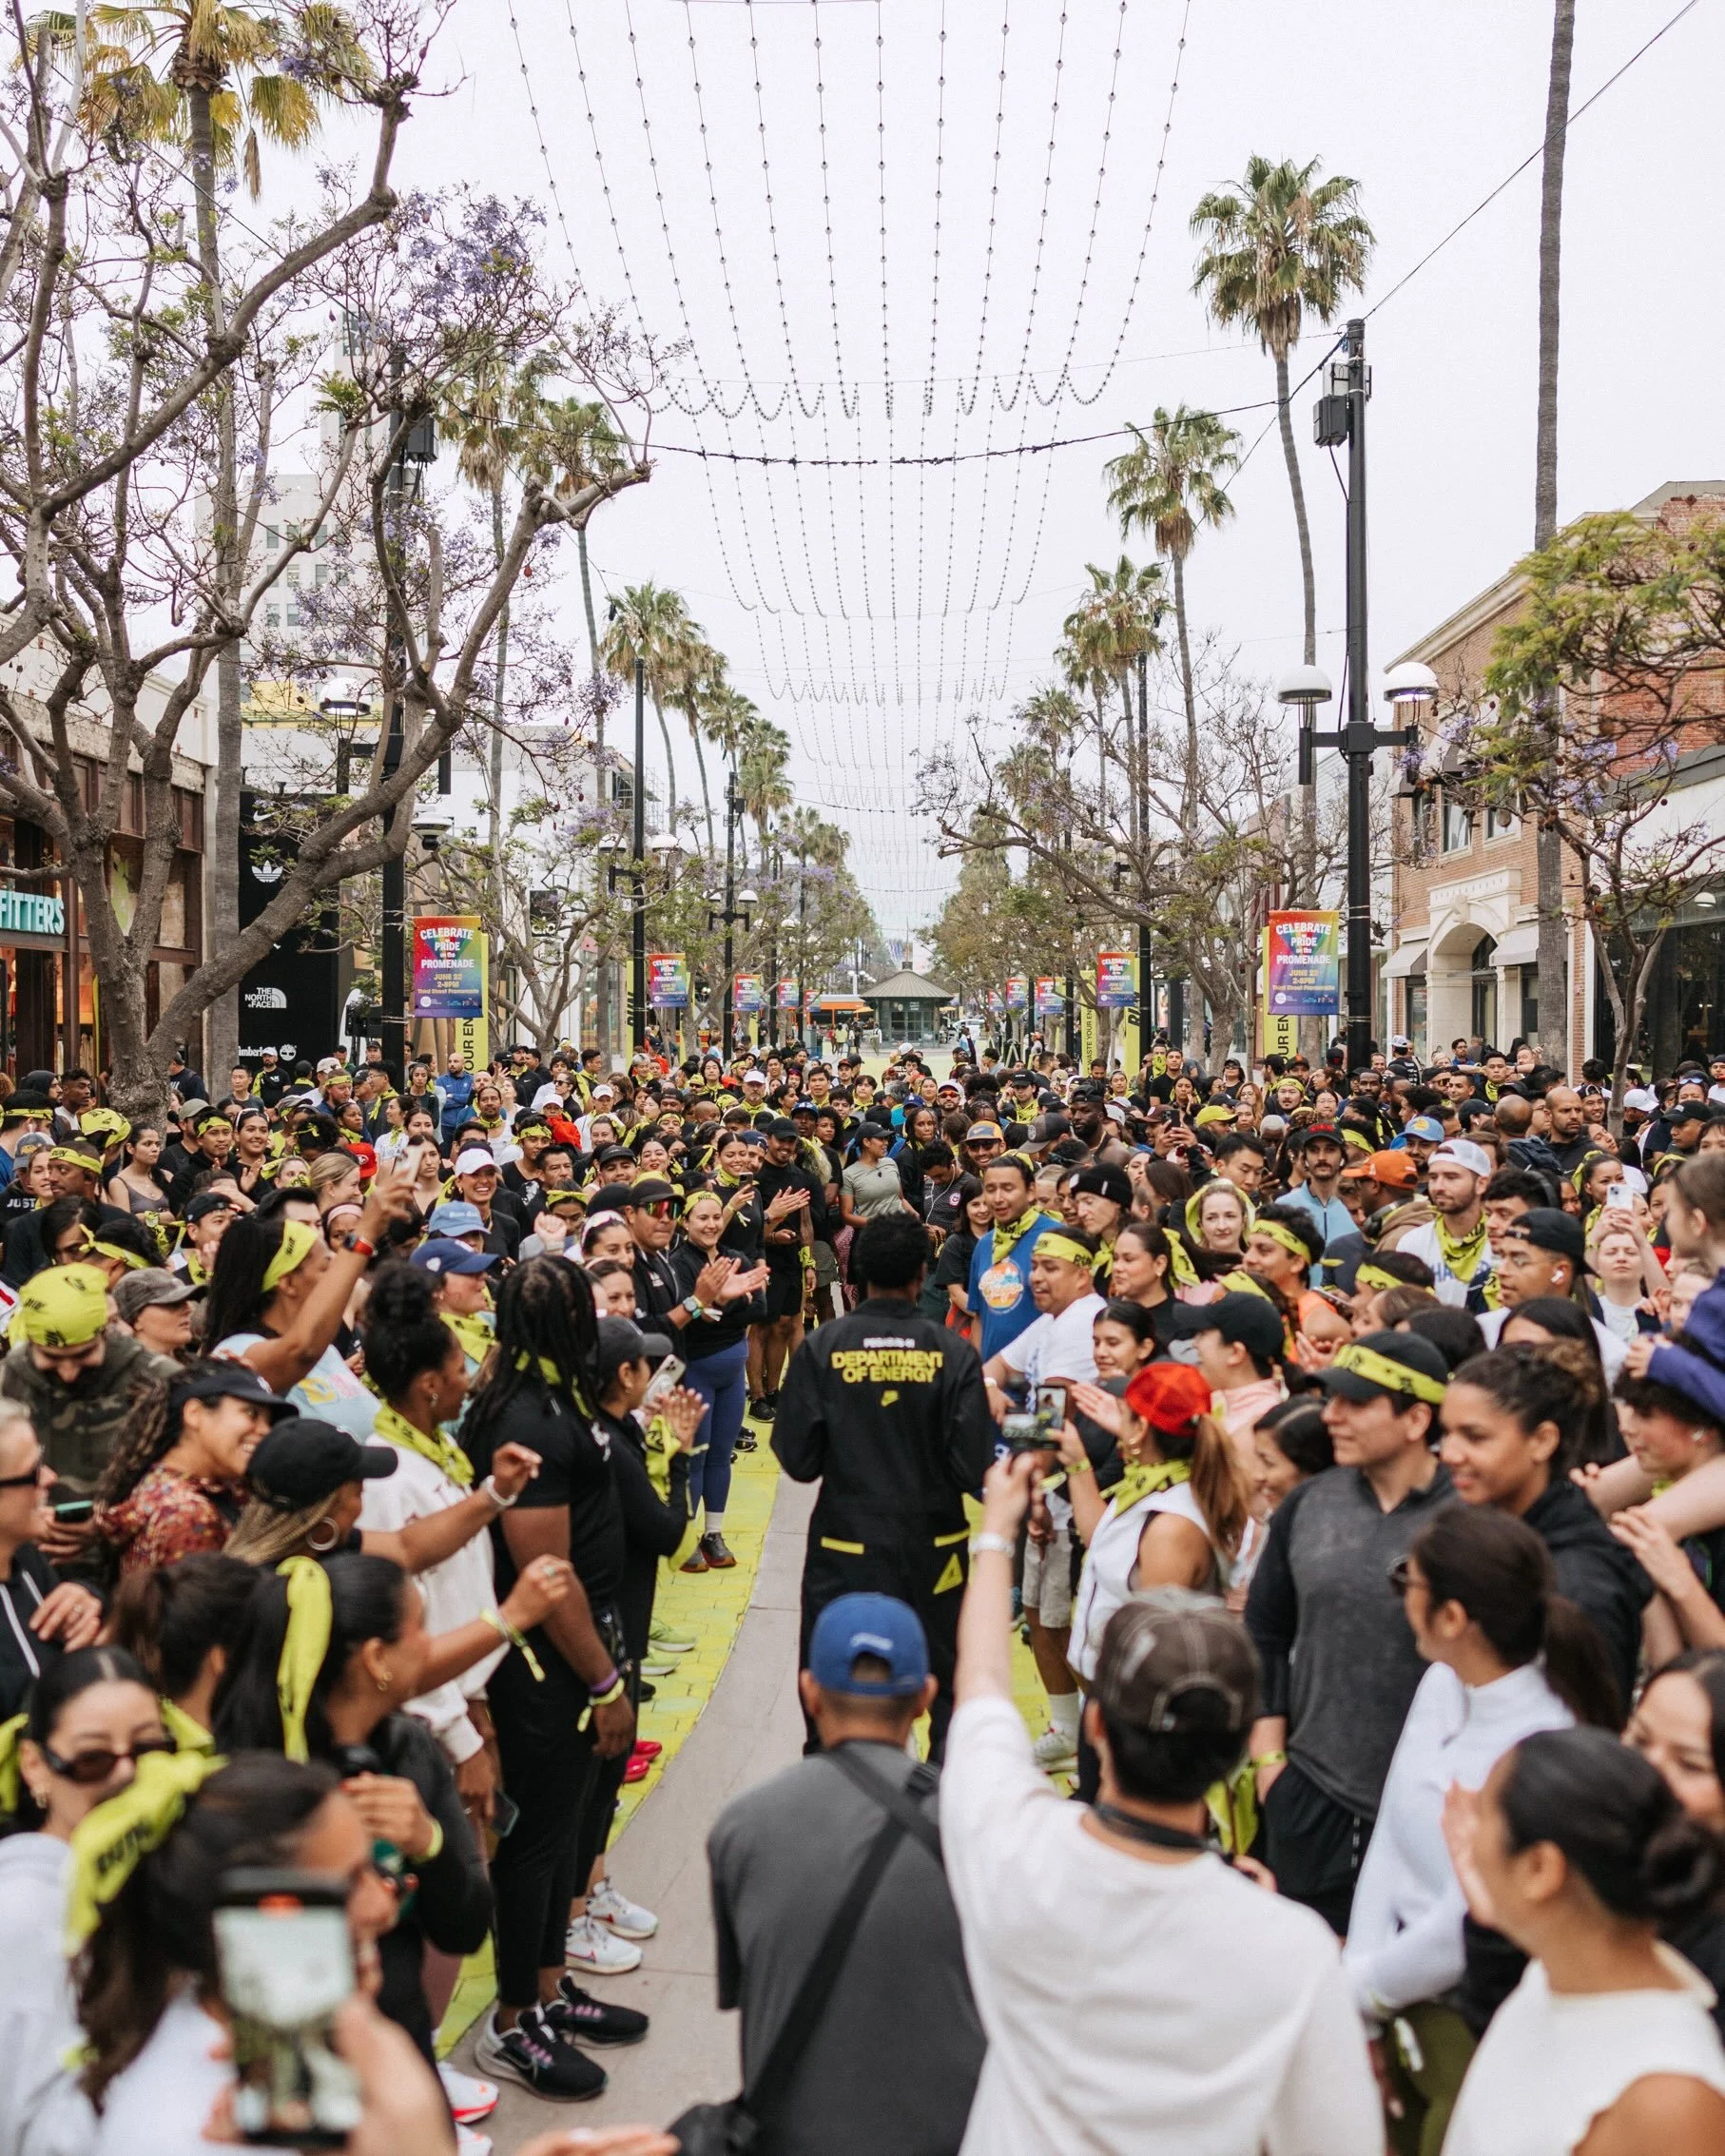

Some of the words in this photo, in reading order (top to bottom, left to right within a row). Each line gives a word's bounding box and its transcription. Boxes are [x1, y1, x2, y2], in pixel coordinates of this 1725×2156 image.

[419, 927, 475, 941] CELEBRATE
[1275, 922, 1332, 935] CELEBRATE
[435, 942, 461, 952] PRIDE
[1290, 937, 1318, 947] PRIDE
[420, 959, 475, 969] PROMENADE
[1276, 954, 1331, 964] PROMENADE
[7, 1198, 37, 1209] JUST
[831, 1350, 944, 1369] DEPARTMENT
[843, 1368, 868, 1383] OF
[869, 1367, 937, 1383] ENERGY
